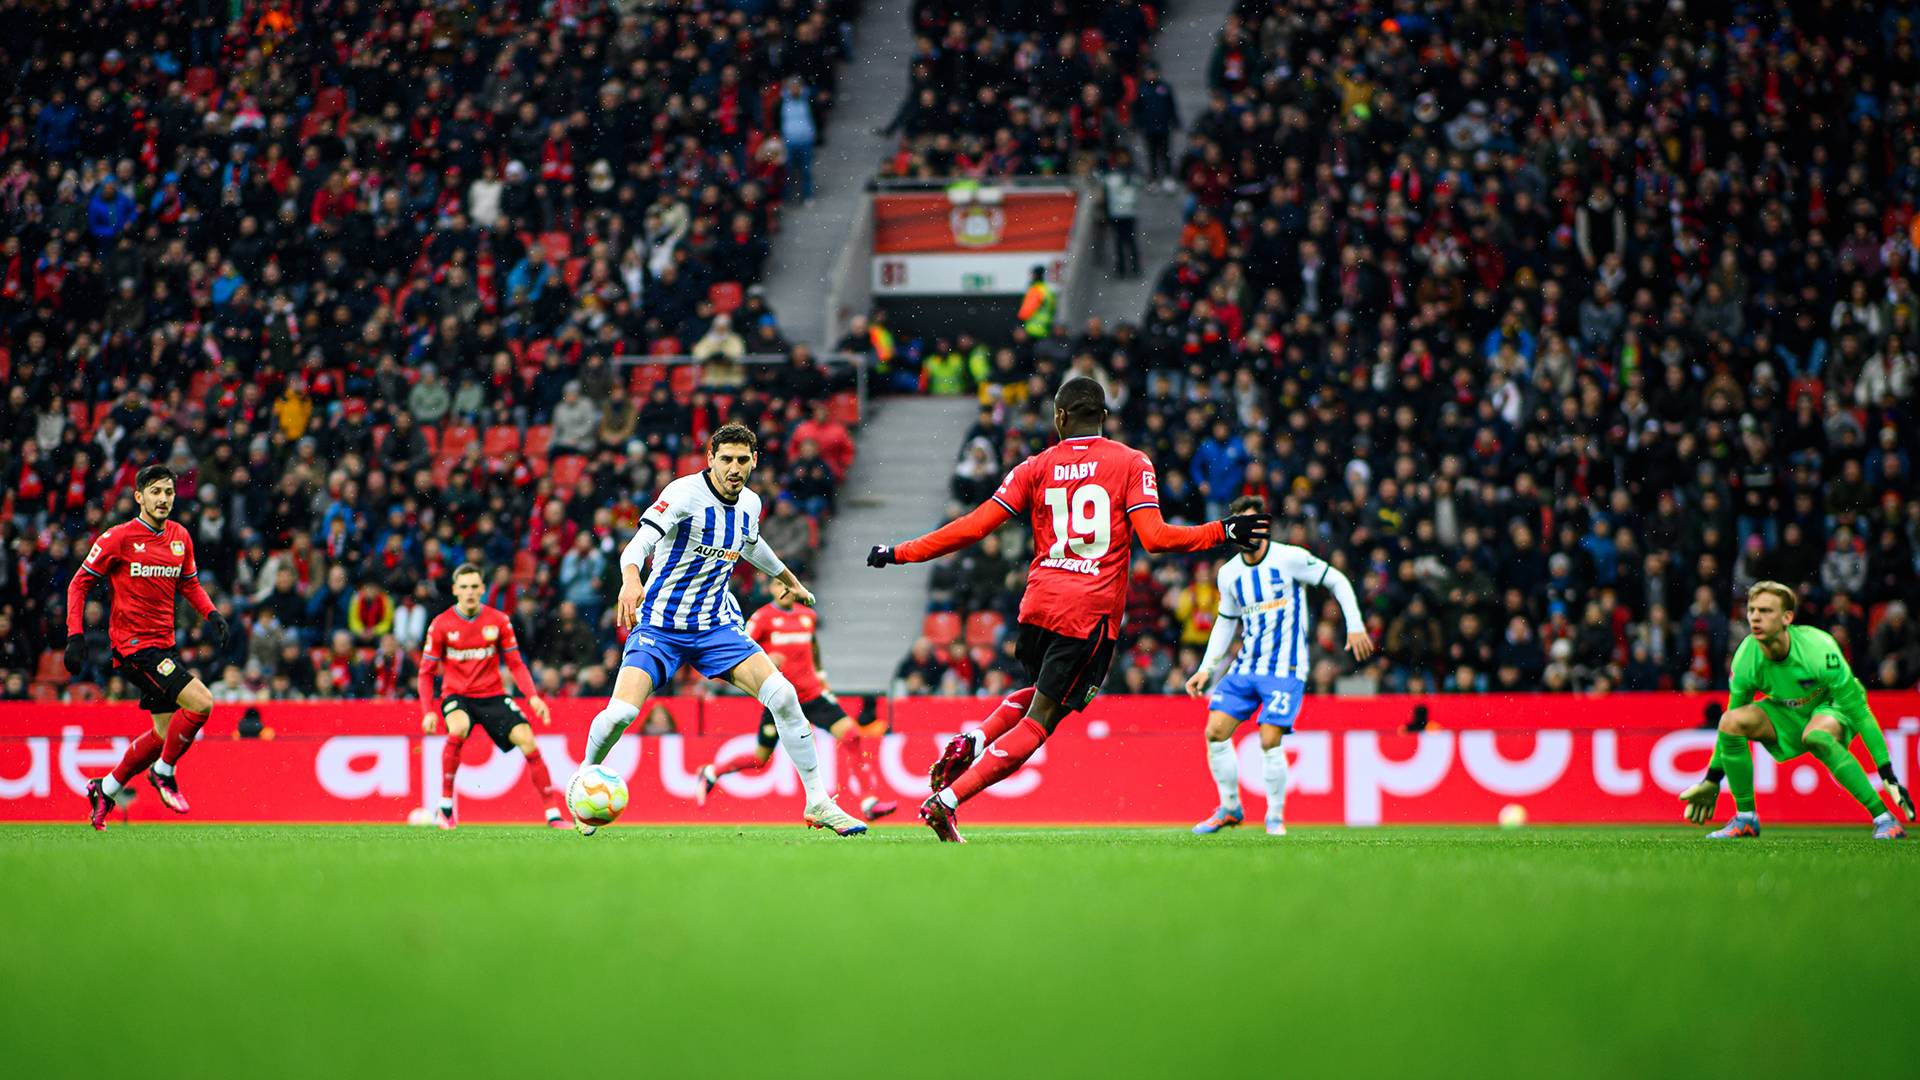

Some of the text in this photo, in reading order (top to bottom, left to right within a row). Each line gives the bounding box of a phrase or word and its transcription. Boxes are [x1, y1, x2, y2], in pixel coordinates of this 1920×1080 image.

[1054, 462, 1098, 480] DIABY
[1045, 484, 1110, 559] 19
[693, 545, 741, 561] AUTOHE
[130, 562, 182, 578] Barmeni
[1268, 690, 1291, 715] 23
